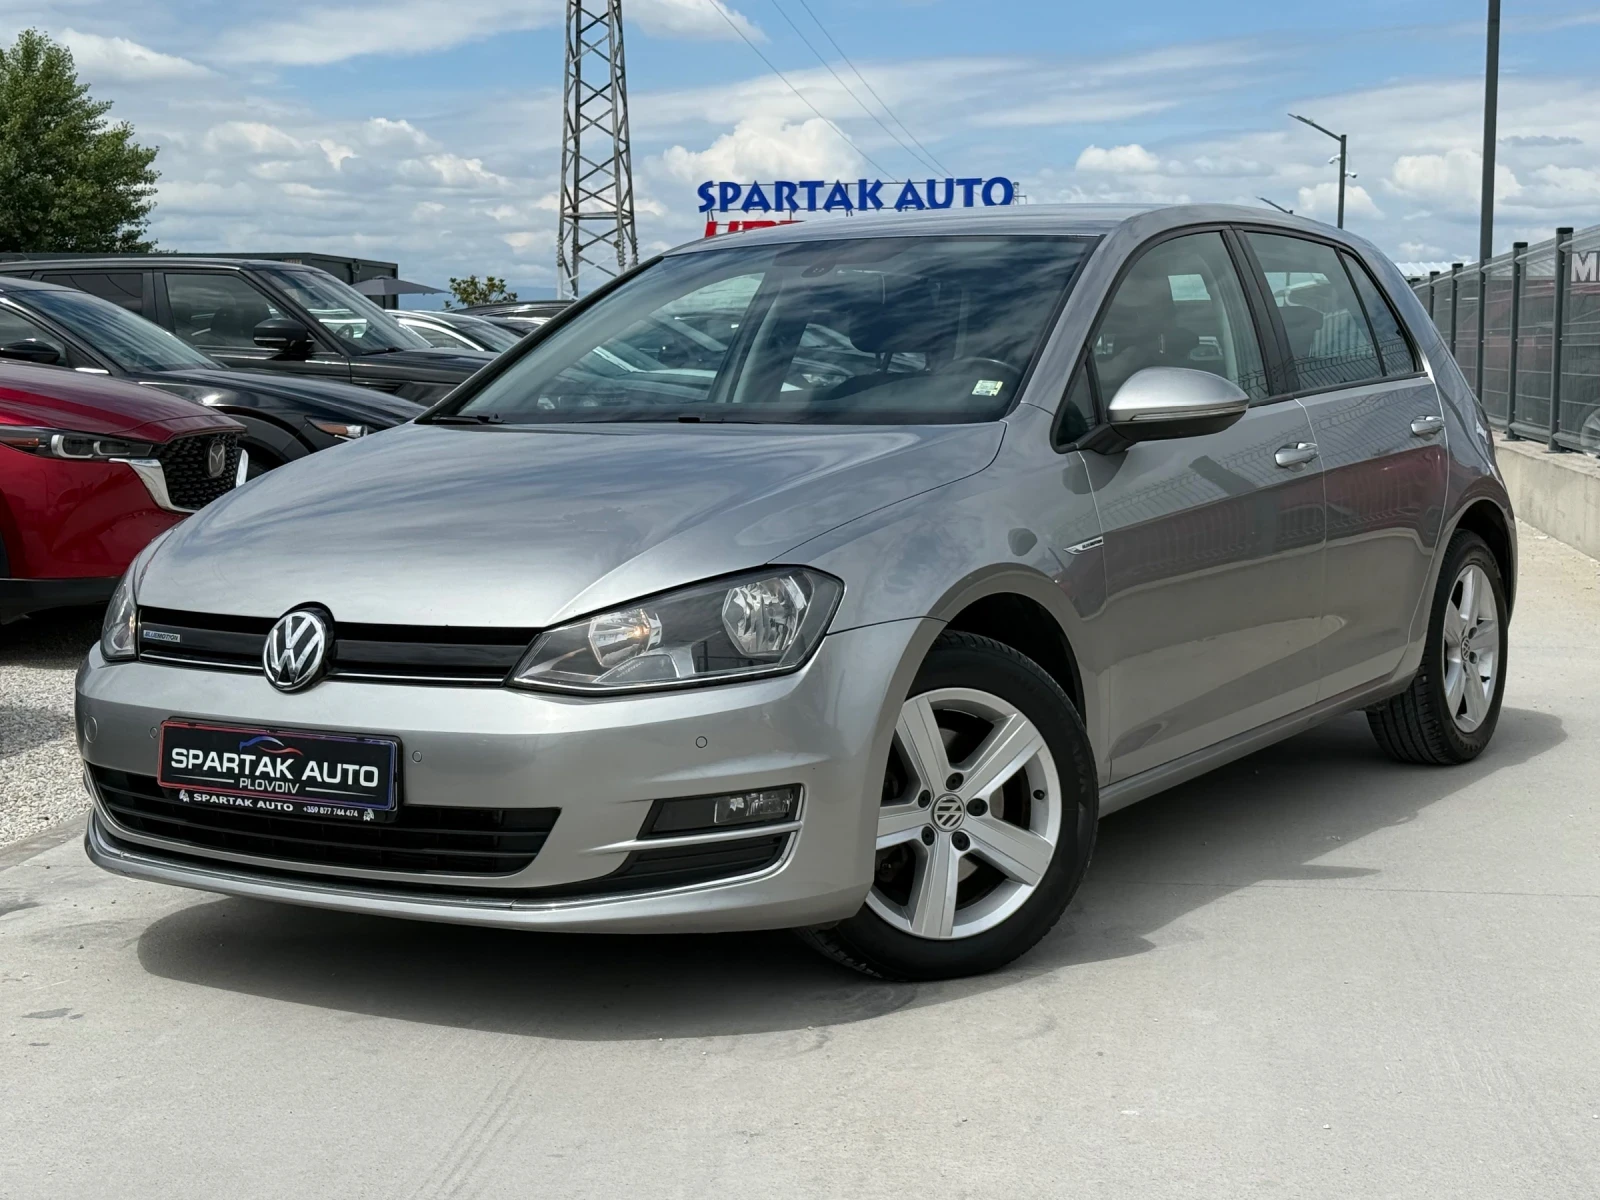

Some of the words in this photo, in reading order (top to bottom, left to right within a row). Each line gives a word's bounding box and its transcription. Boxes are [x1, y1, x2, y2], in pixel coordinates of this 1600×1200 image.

[697, 178, 884, 212] SPARTAK
[894, 176, 1015, 212] AUTO
[171, 747, 294, 780] SPARTAK
[301, 760, 379, 788] AUTO
[239, 777, 300, 794] PLOVDIV
[193, 792, 253, 808] SPARTAK
[256, 799, 294, 812] AUTO
[302, 805, 318, 814] +359
[319, 806, 332, 815] 877
[333, 808, 345, 817] 744
[346, 809, 358, 818] 474
